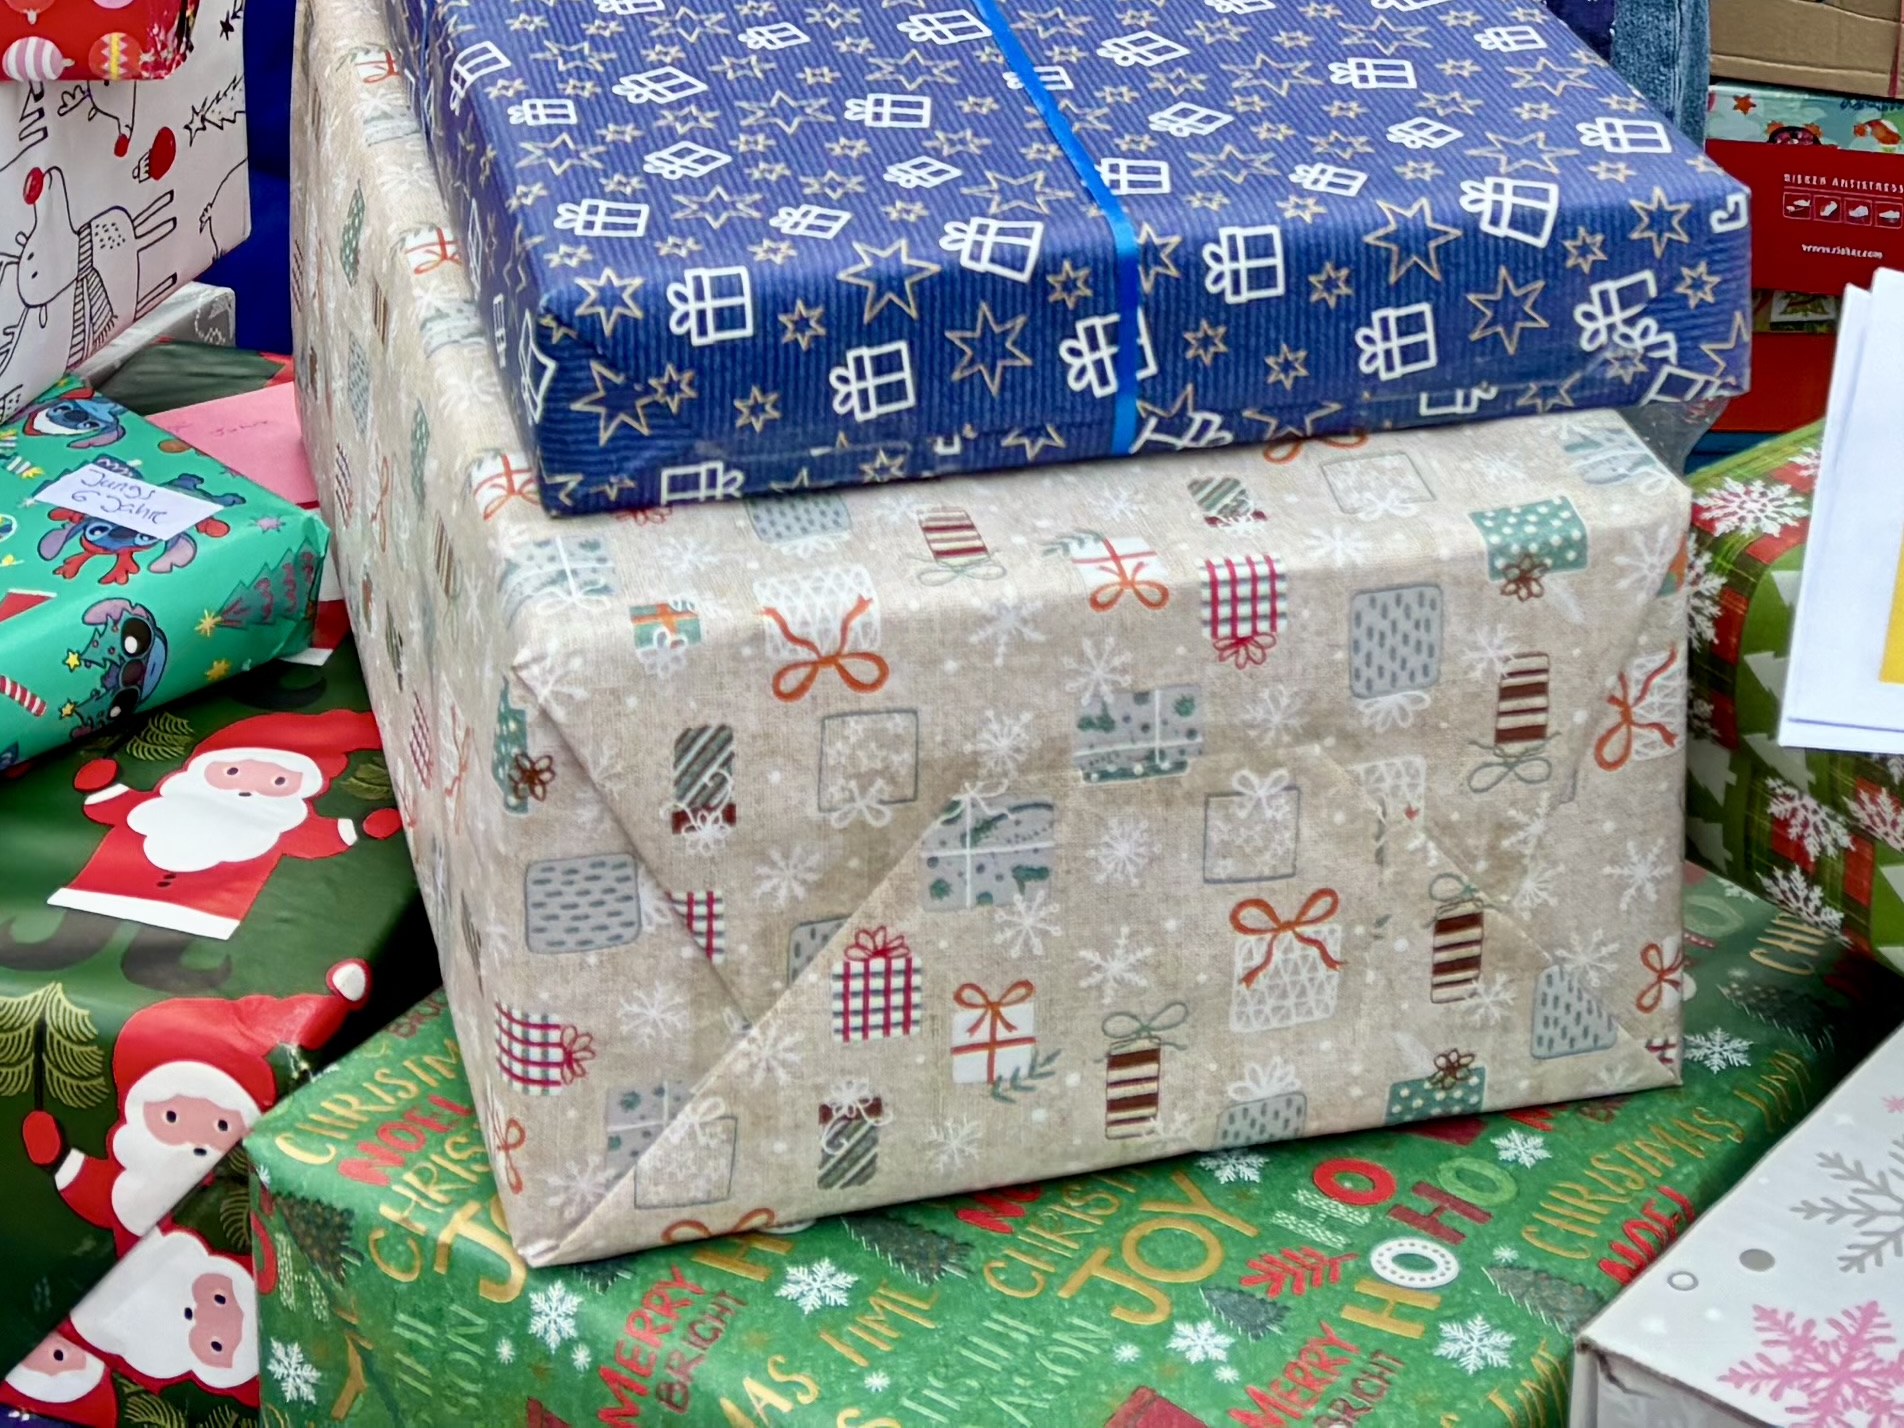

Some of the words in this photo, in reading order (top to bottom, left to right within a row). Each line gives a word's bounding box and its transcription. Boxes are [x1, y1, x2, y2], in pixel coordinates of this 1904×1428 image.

[337, 1094, 474, 1186] NOEL
[1521, 1106, 1745, 1260] CHRISTMAS
[1057, 1171, 1259, 1326] JOY
[597, 1264, 708, 1428] MERRY
[656, 1288, 747, 1415] BRIGHT
[1227, 1319, 1361, 1428] MERRY
